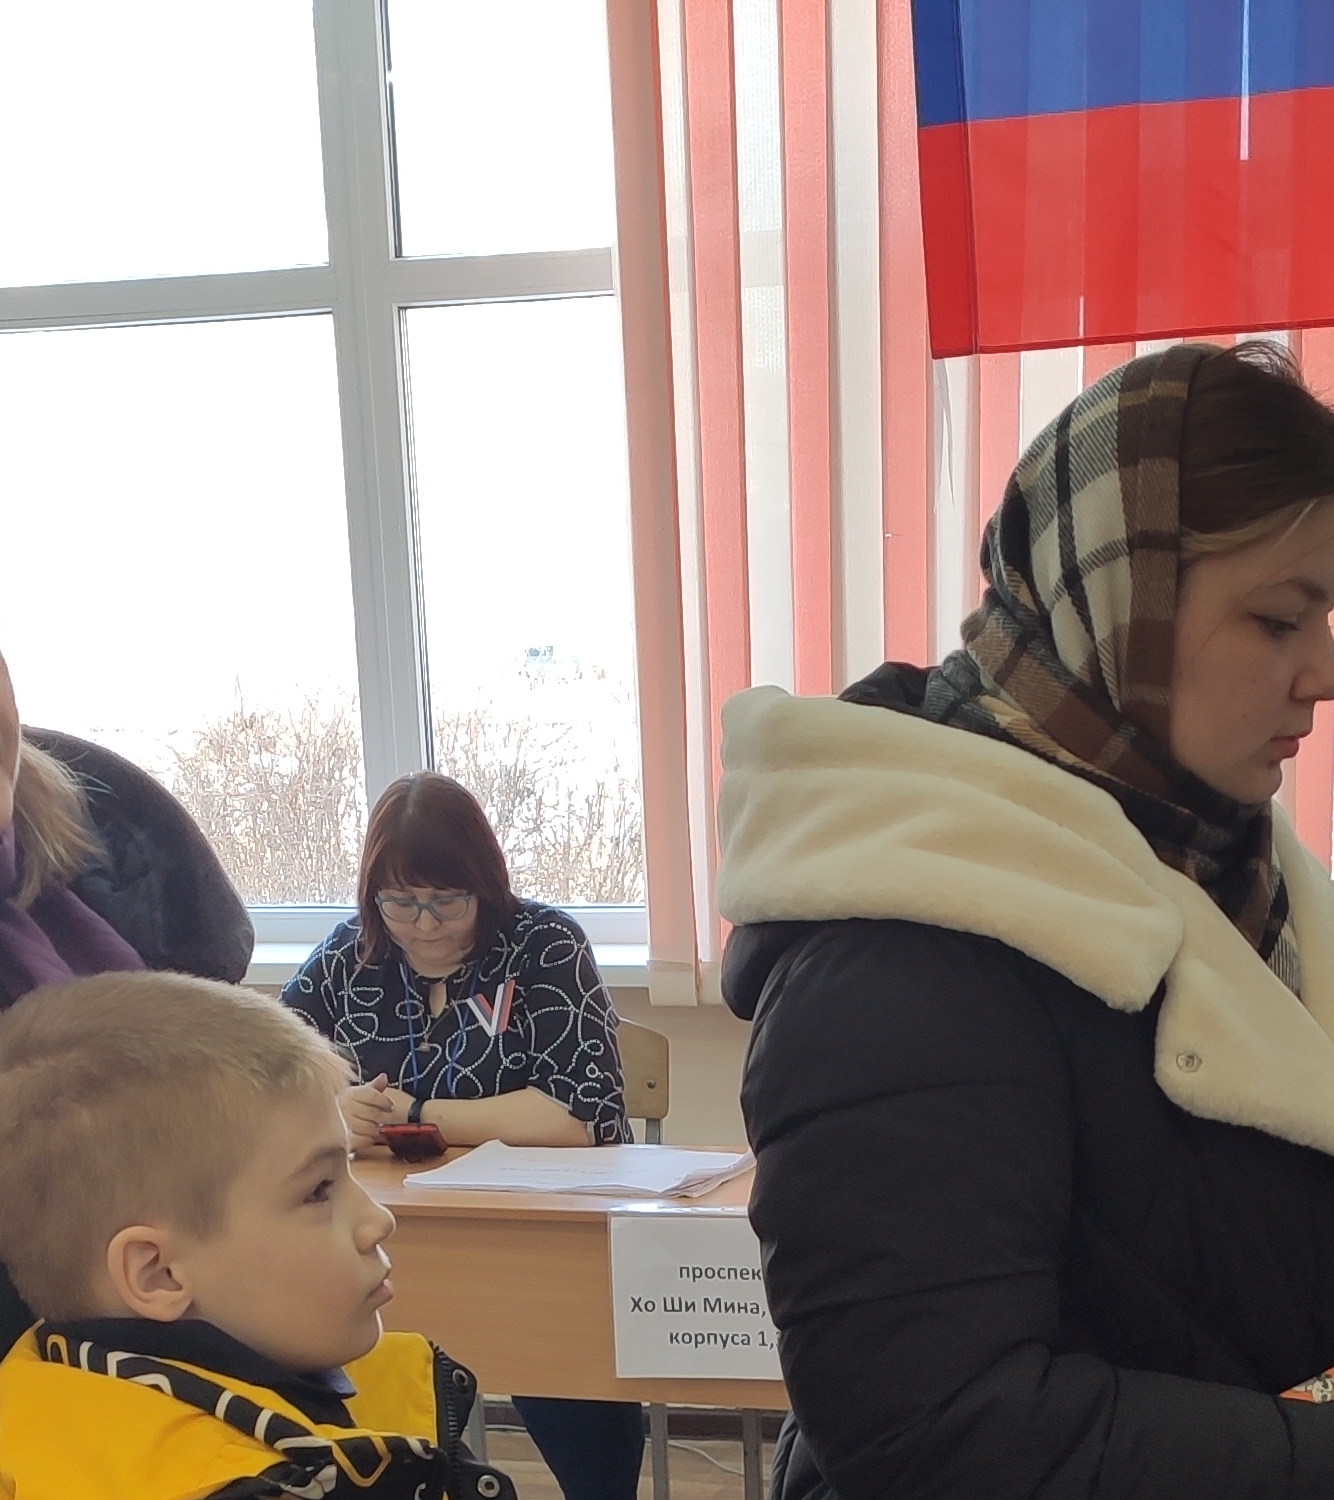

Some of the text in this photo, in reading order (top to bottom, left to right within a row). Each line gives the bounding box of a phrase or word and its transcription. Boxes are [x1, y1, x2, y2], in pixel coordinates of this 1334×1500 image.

[630, 1296, 766, 1318] Хо Ши Мина,
[669, 1331, 751, 1350] корпуса
